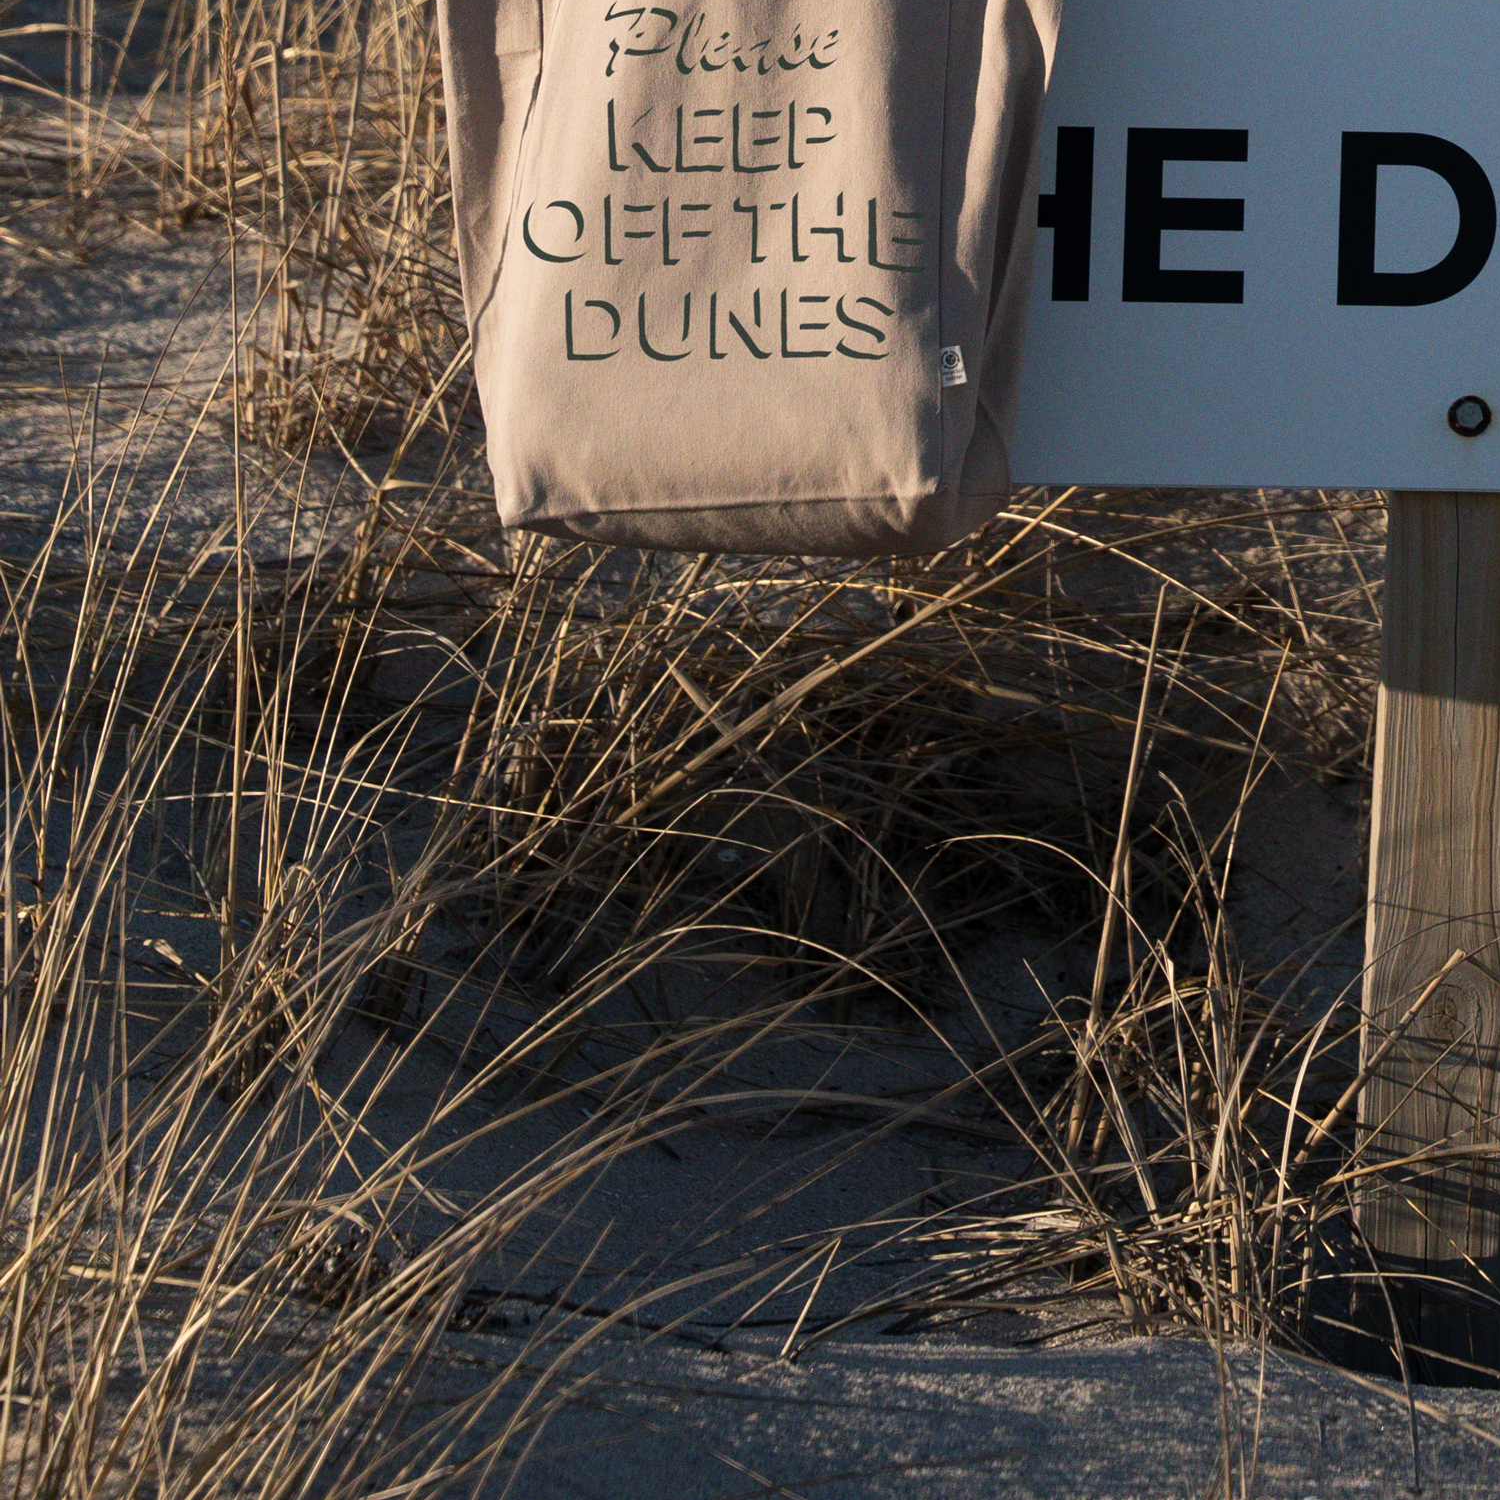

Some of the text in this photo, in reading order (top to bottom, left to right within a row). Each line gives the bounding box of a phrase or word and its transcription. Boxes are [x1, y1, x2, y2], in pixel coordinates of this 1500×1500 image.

[604, 0, 841, 77] Please
[607, 98, 837, 174] KEEP
[523, 191, 925, 273] OFF THE
[565, 287, 896, 362] DUNES
